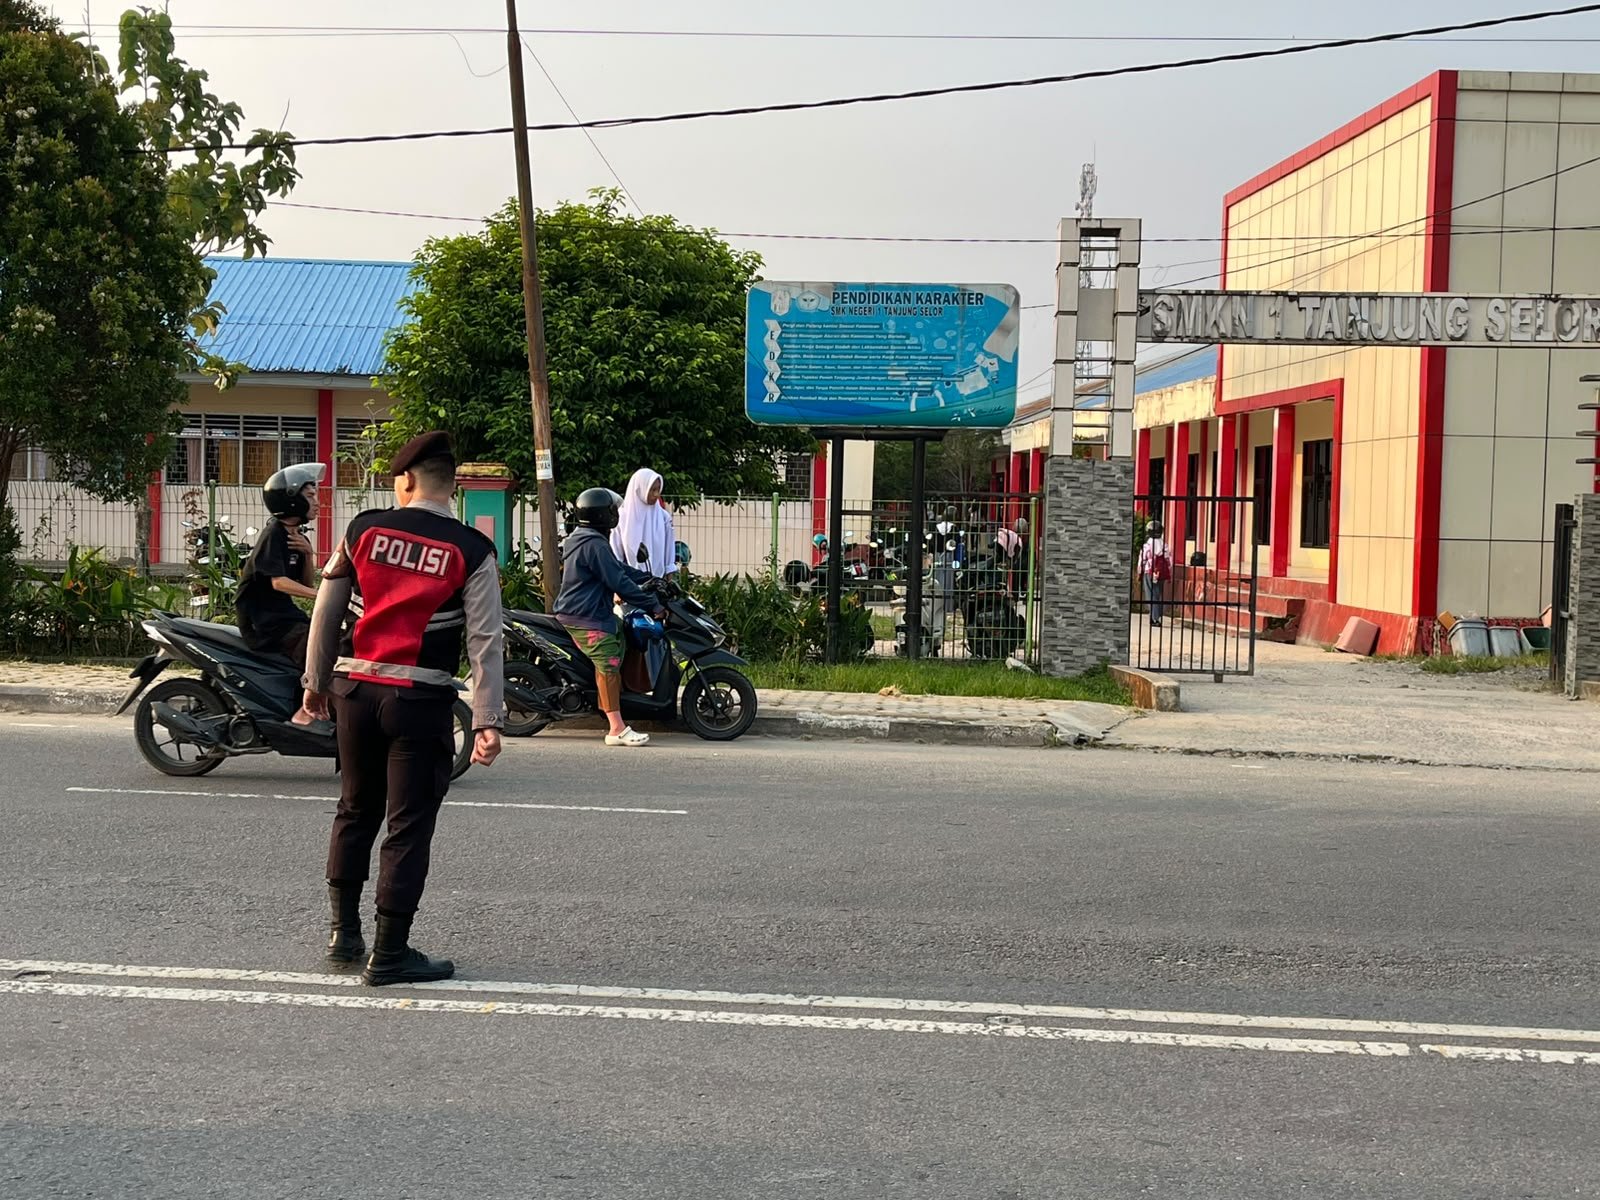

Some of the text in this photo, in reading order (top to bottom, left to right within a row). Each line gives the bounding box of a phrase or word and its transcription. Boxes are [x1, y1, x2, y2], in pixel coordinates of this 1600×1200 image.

[831, 307, 846, 315] SMK
[848, 307, 875, 316] NEGERI
[884, 307, 917, 316] TANJUNG
[919, 307, 943, 316] SELOR
[832, 292, 984, 305] PENDIDIKAN KARAKTER
[1152, 294, 1252, 339] SMKN
[1268, 295, 1282, 339] 1
[1299, 296, 1470, 341] TANJUNG
[370, 534, 450, 576] POLISI
